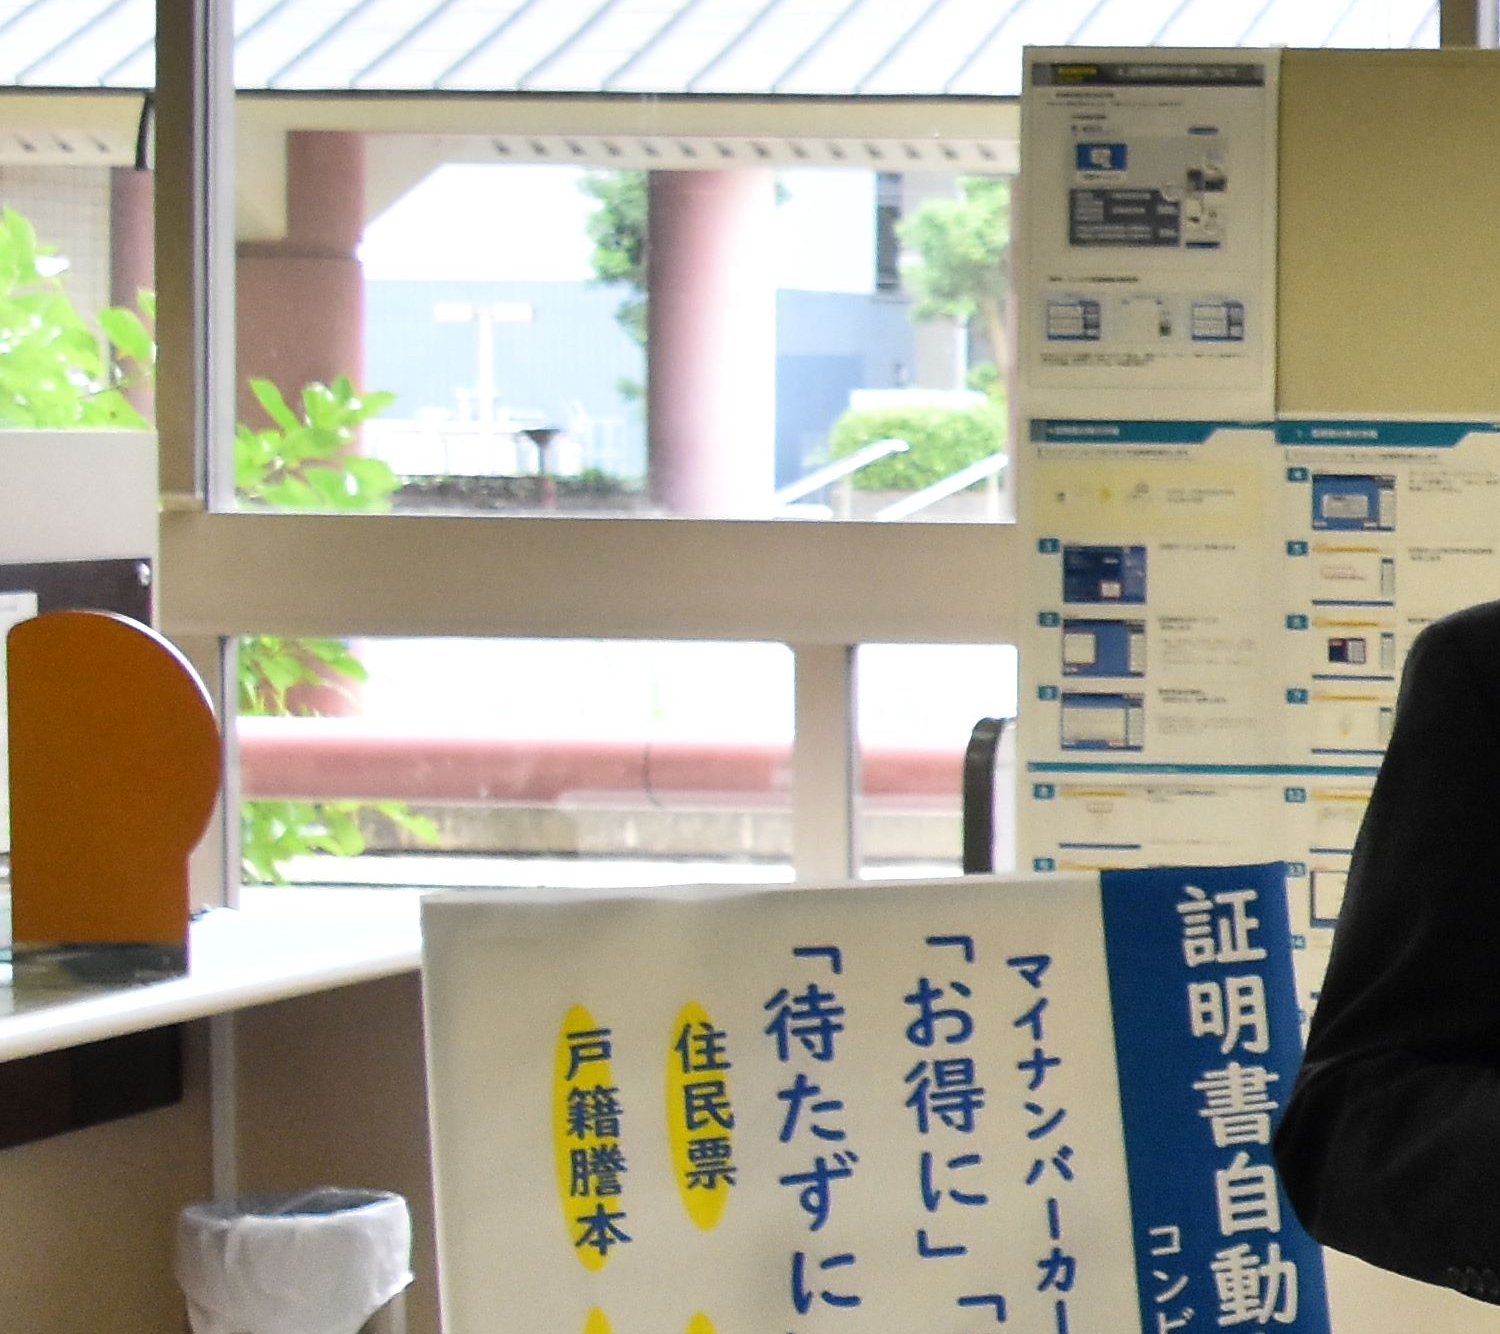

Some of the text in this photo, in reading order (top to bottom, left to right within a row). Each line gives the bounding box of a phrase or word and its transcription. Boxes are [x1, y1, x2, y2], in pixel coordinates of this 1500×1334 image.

[563, 1027, 633, 1259] 戸籍謄本
[674, 1019, 738, 1194] 住民票
